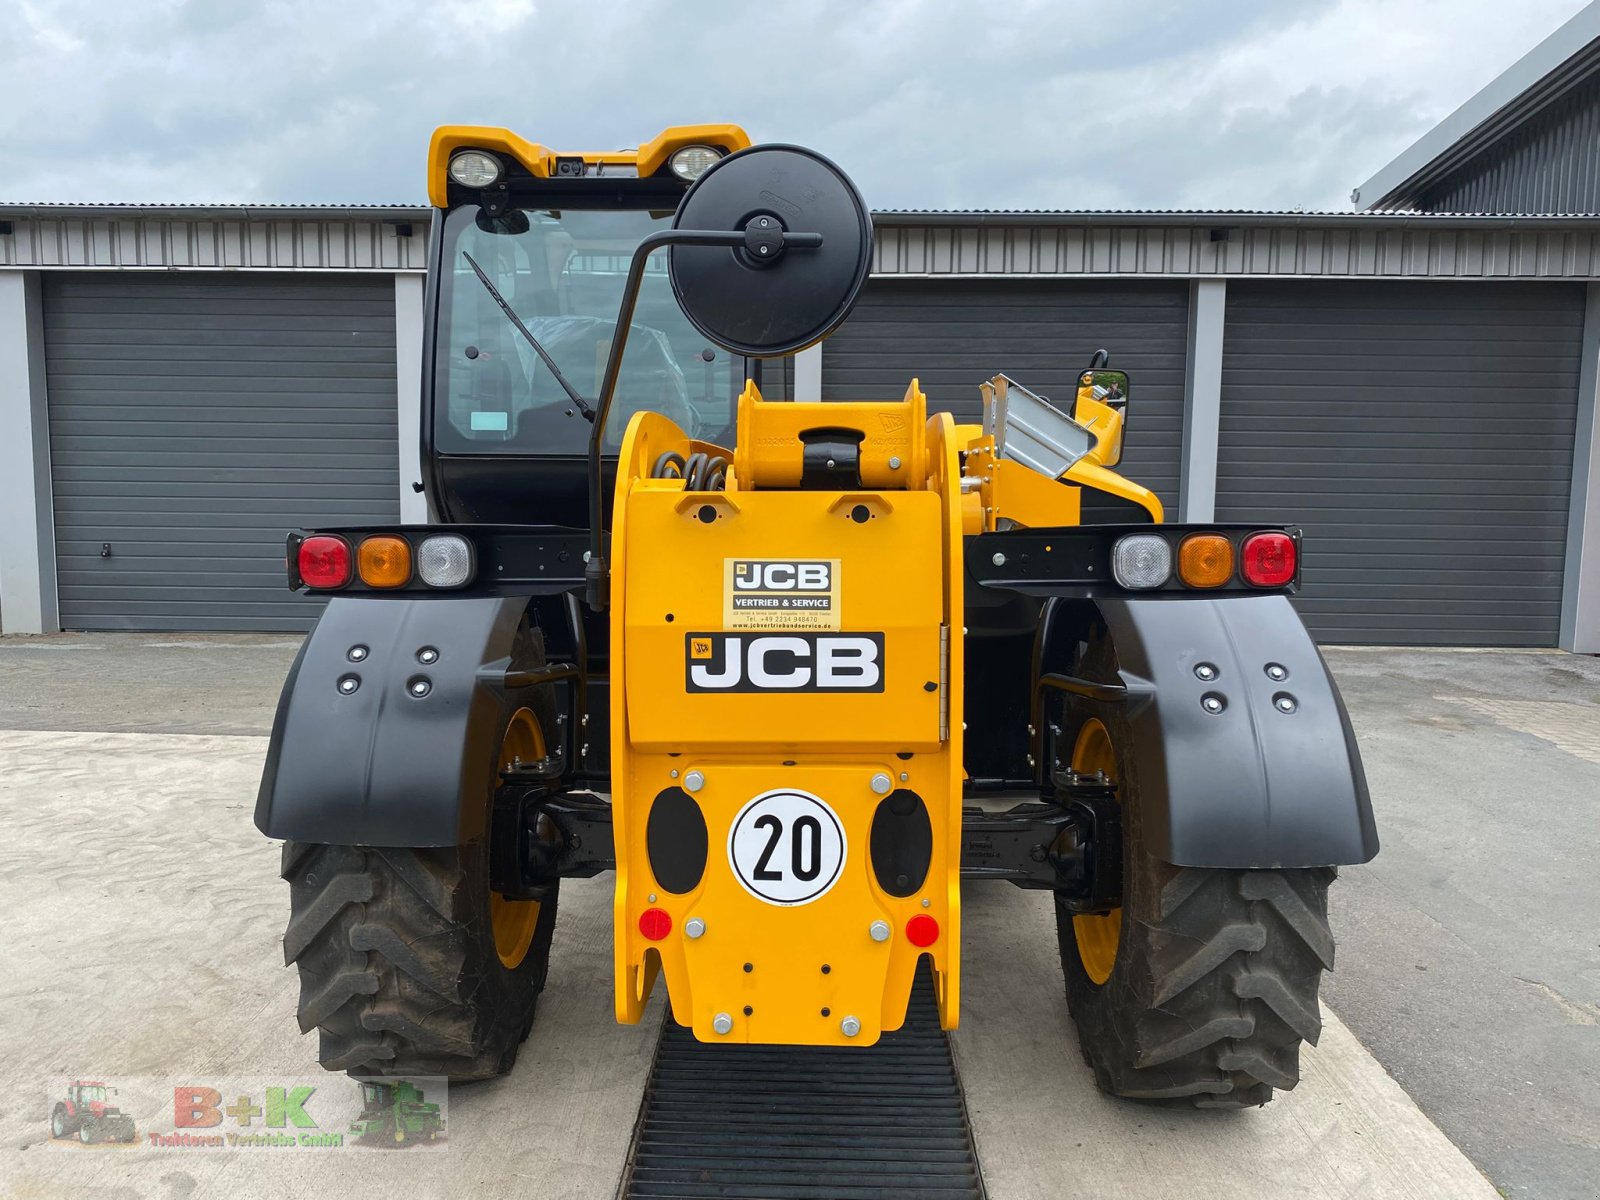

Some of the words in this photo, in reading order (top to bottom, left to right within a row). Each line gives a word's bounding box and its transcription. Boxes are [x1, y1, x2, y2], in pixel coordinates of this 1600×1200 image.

[736, 564, 829, 589] JCB
[735, 598, 779, 607] VERTRIEB
[782, 599, 790, 607] &
[792, 599, 829, 607] SERVICE
[691, 637, 880, 688] JCB
[753, 814, 822, 882] 20
